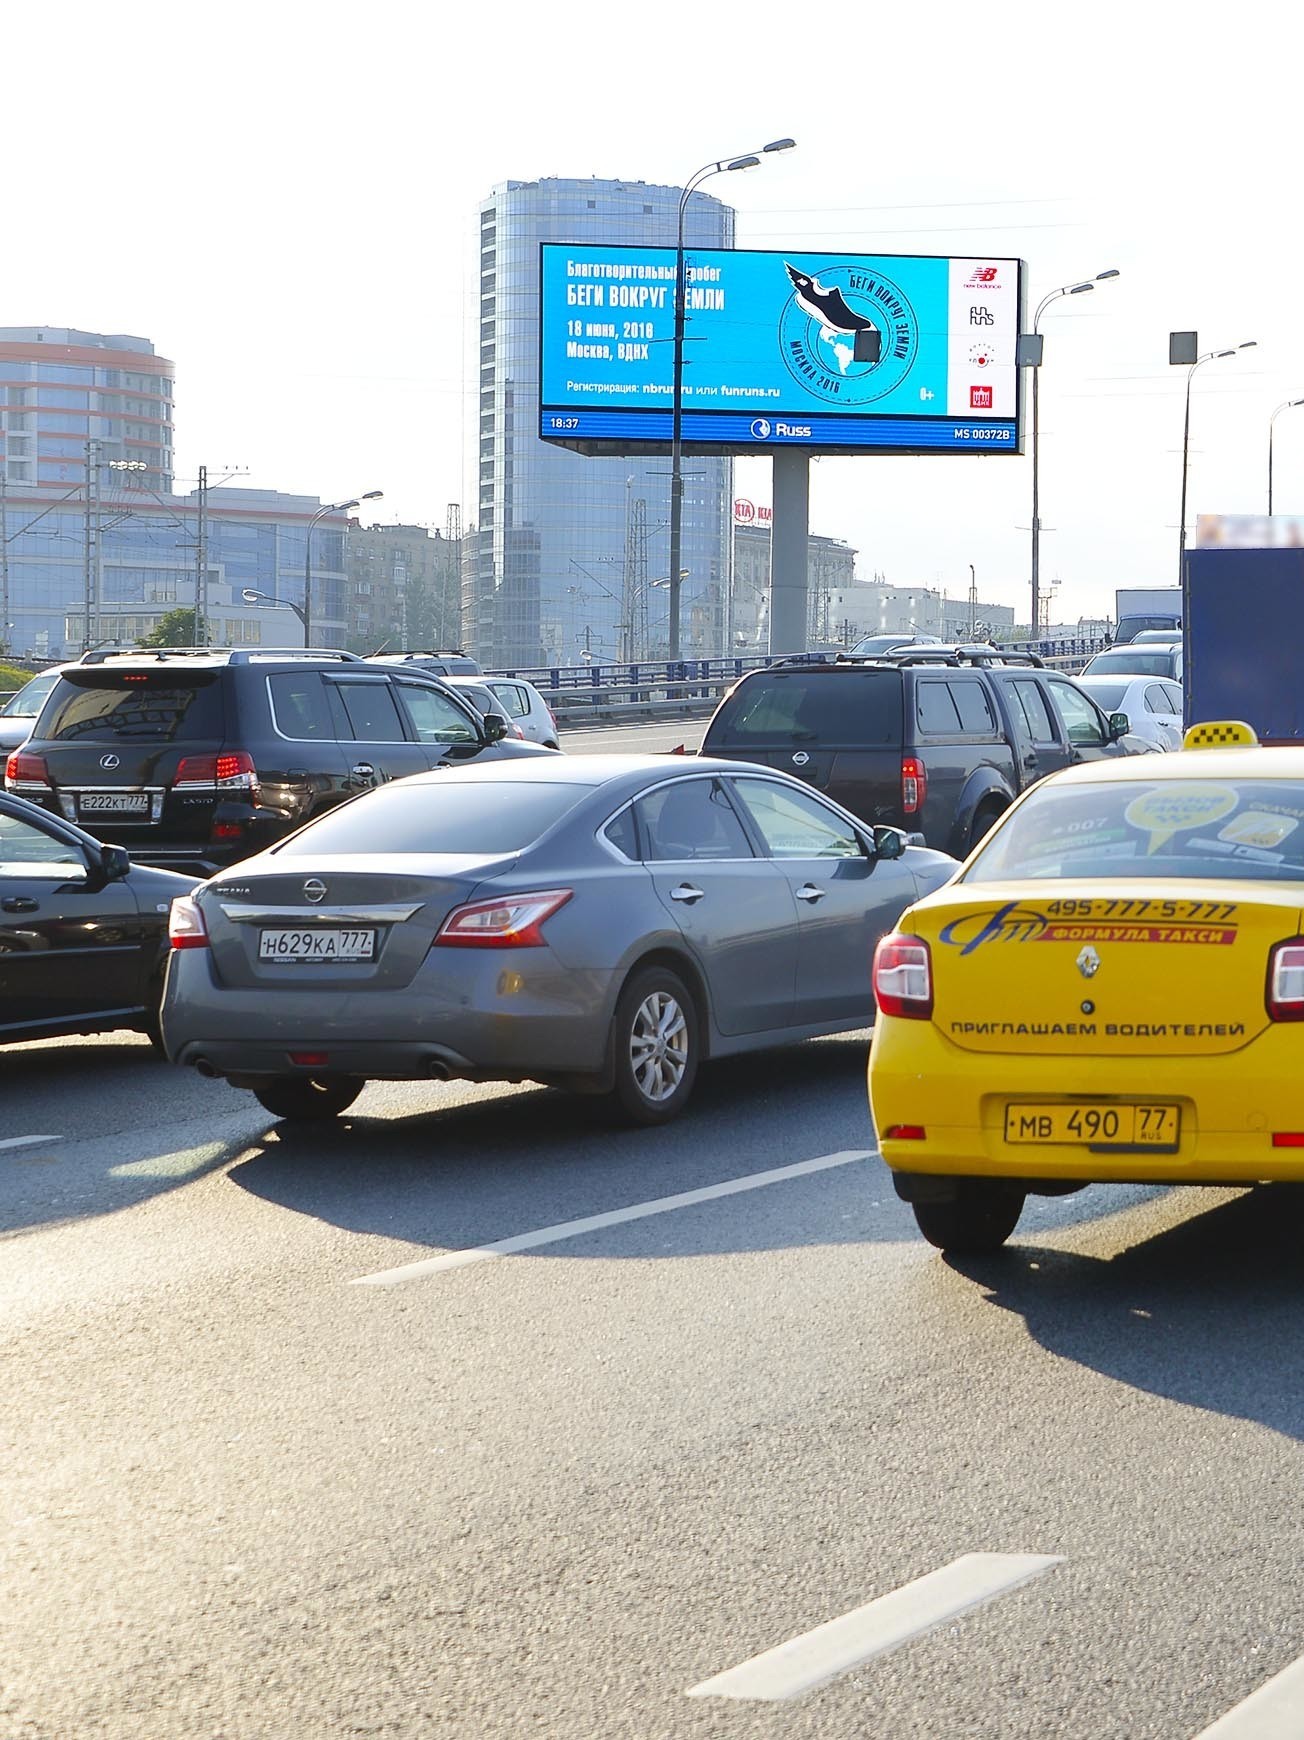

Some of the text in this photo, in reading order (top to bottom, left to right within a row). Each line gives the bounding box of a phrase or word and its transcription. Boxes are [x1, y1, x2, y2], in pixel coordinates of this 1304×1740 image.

[567, 284, 604, 306] БЕГИ
[609, 285, 667, 309] ВОКРУГ
[849, 274, 910, 360] БЕГИ ВОКРУГ ЗЕМЛИ
[567, 320, 582, 337] 18
[586, 323, 619, 340] июня,
[567, 341, 649, 362] Москва, ВДНХ
[789, 340, 841, 394] МОСКВА 2016
[643, 383, 692, 395] nbrunru
[696, 386, 718, 395] или
[720, 385, 781, 397] funruns.ru
[550, 417, 579, 429] 18:37
[775, 422, 812, 438] Russ
[954, 428, 1010, 440] MS 00372B
[341, 931, 369, 948] 777
[1052, 927, 1224, 943] ФОРМУЛА ТАКСИ
[951, 1021, 1245, 1036] ПРИГЛАШАЕМ ВОДИТЕЛЕЙ
[1066, 1109, 1119, 1138] 490
[1139, 1108, 1167, 1130] 77
